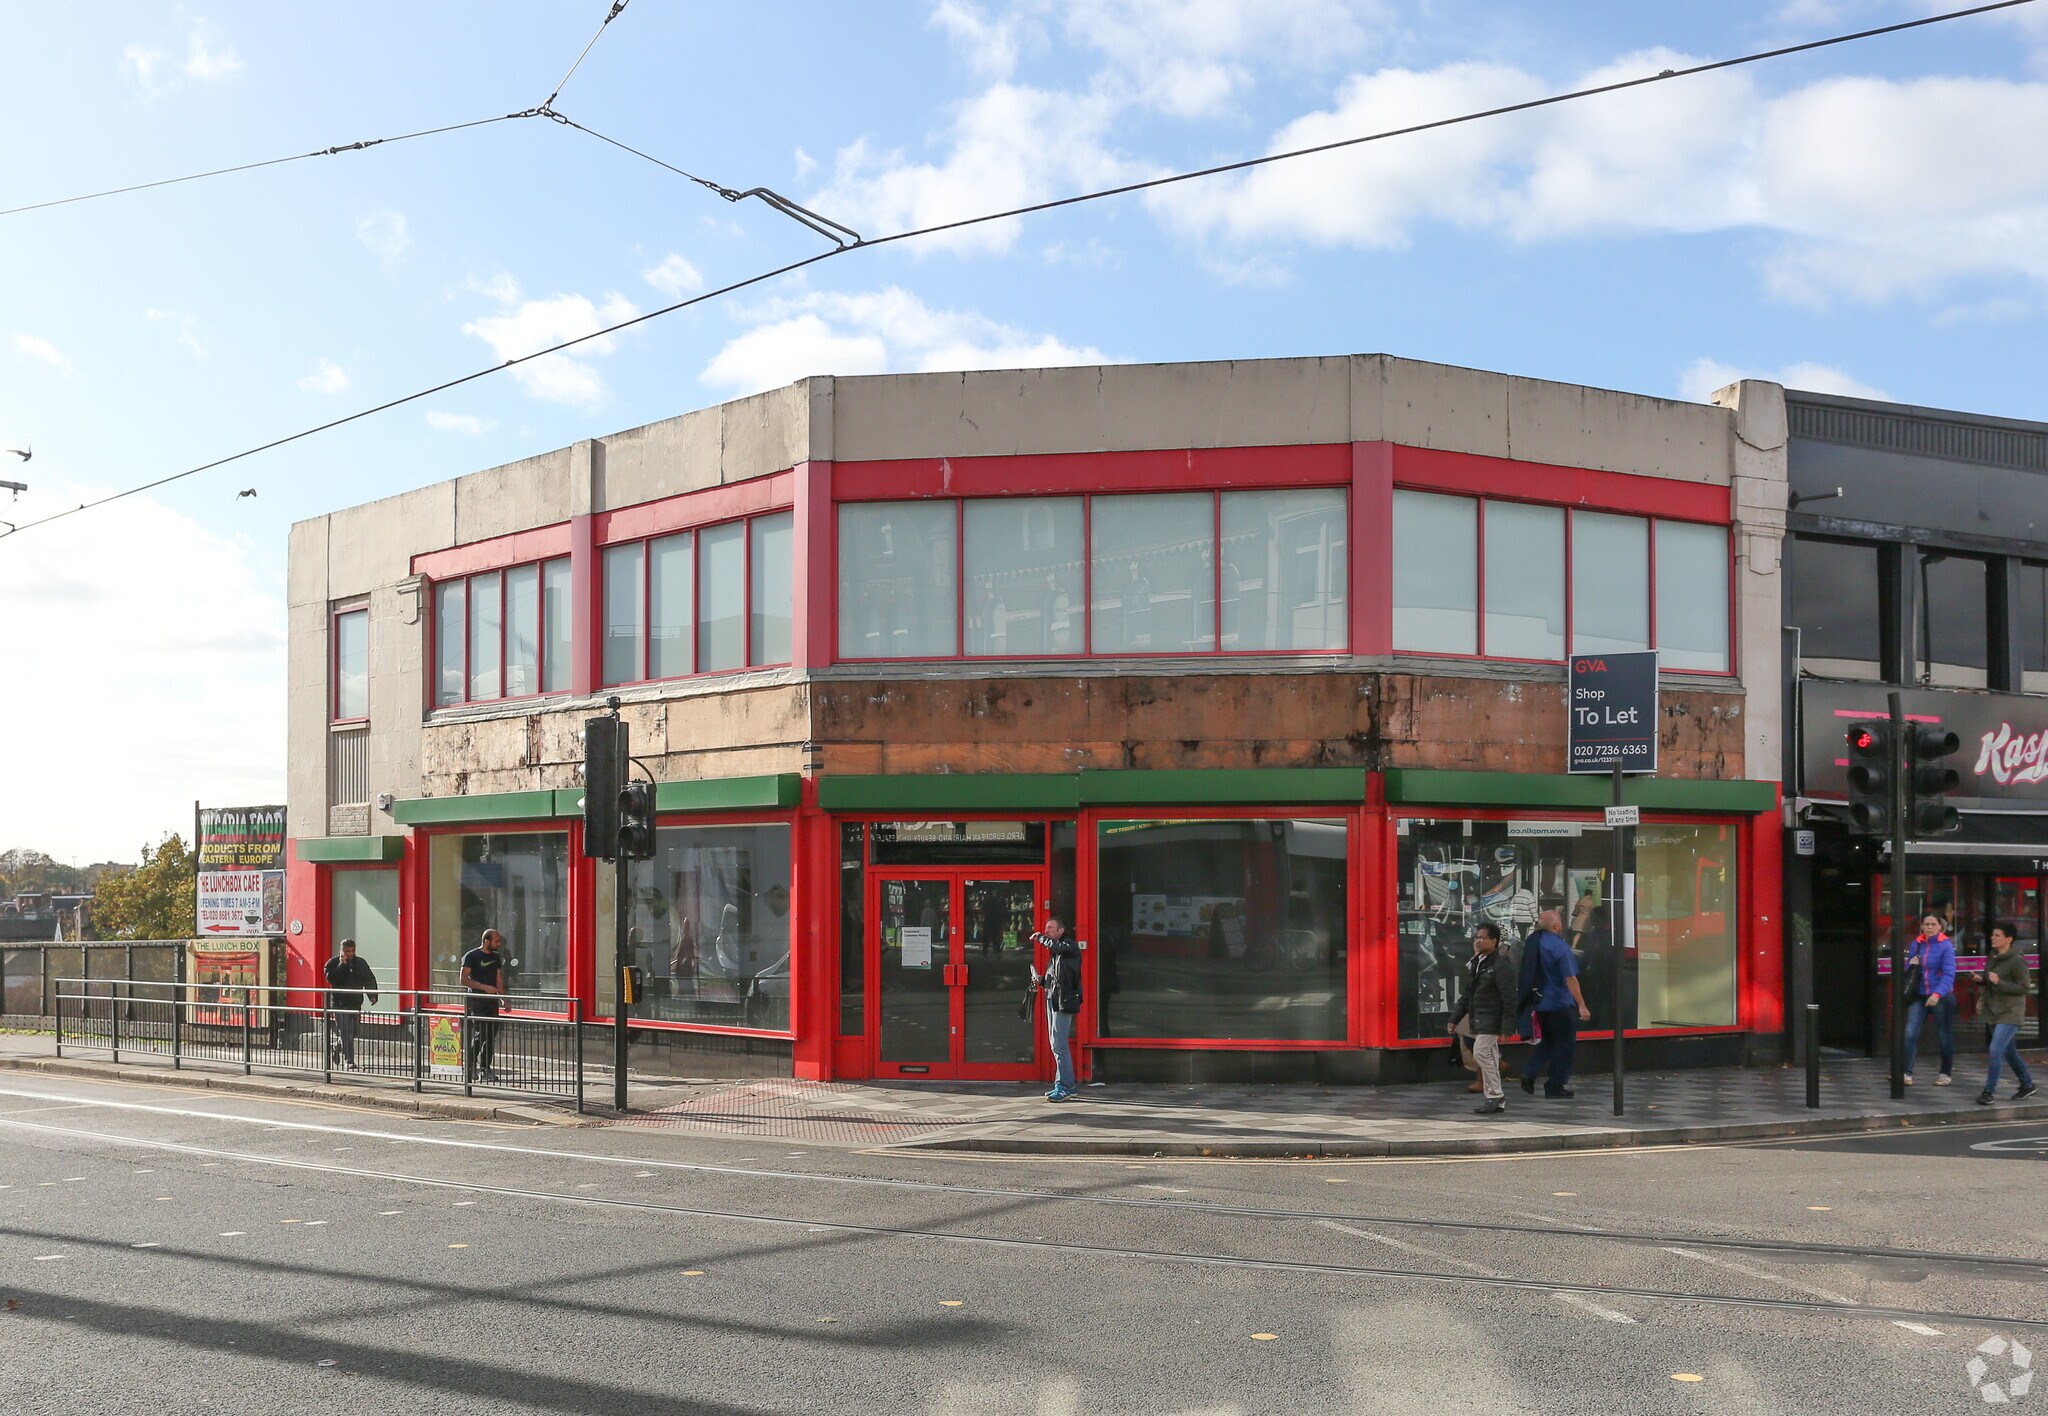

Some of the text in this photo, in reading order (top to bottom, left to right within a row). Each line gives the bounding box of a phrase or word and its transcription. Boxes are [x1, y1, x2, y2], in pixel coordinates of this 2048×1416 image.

[1575, 659, 1608, 673] GVA
[1575, 688, 1605, 701] Shop
[1575, 706, 1638, 725] To Let
[1574, 744, 1648, 756] 020 7236 6363
[249, 811, 283, 842] FOOD
[247, 843, 280, 853] FROM
[201, 855, 273, 864] EASTERN EUROPE
[210, 875, 242, 892] LUNCHBOX
[243, 874, 260, 892] CAFE
[220, 898, 234, 908] TIMES
[196, 941, 259, 951] THE LUNCH BOX
